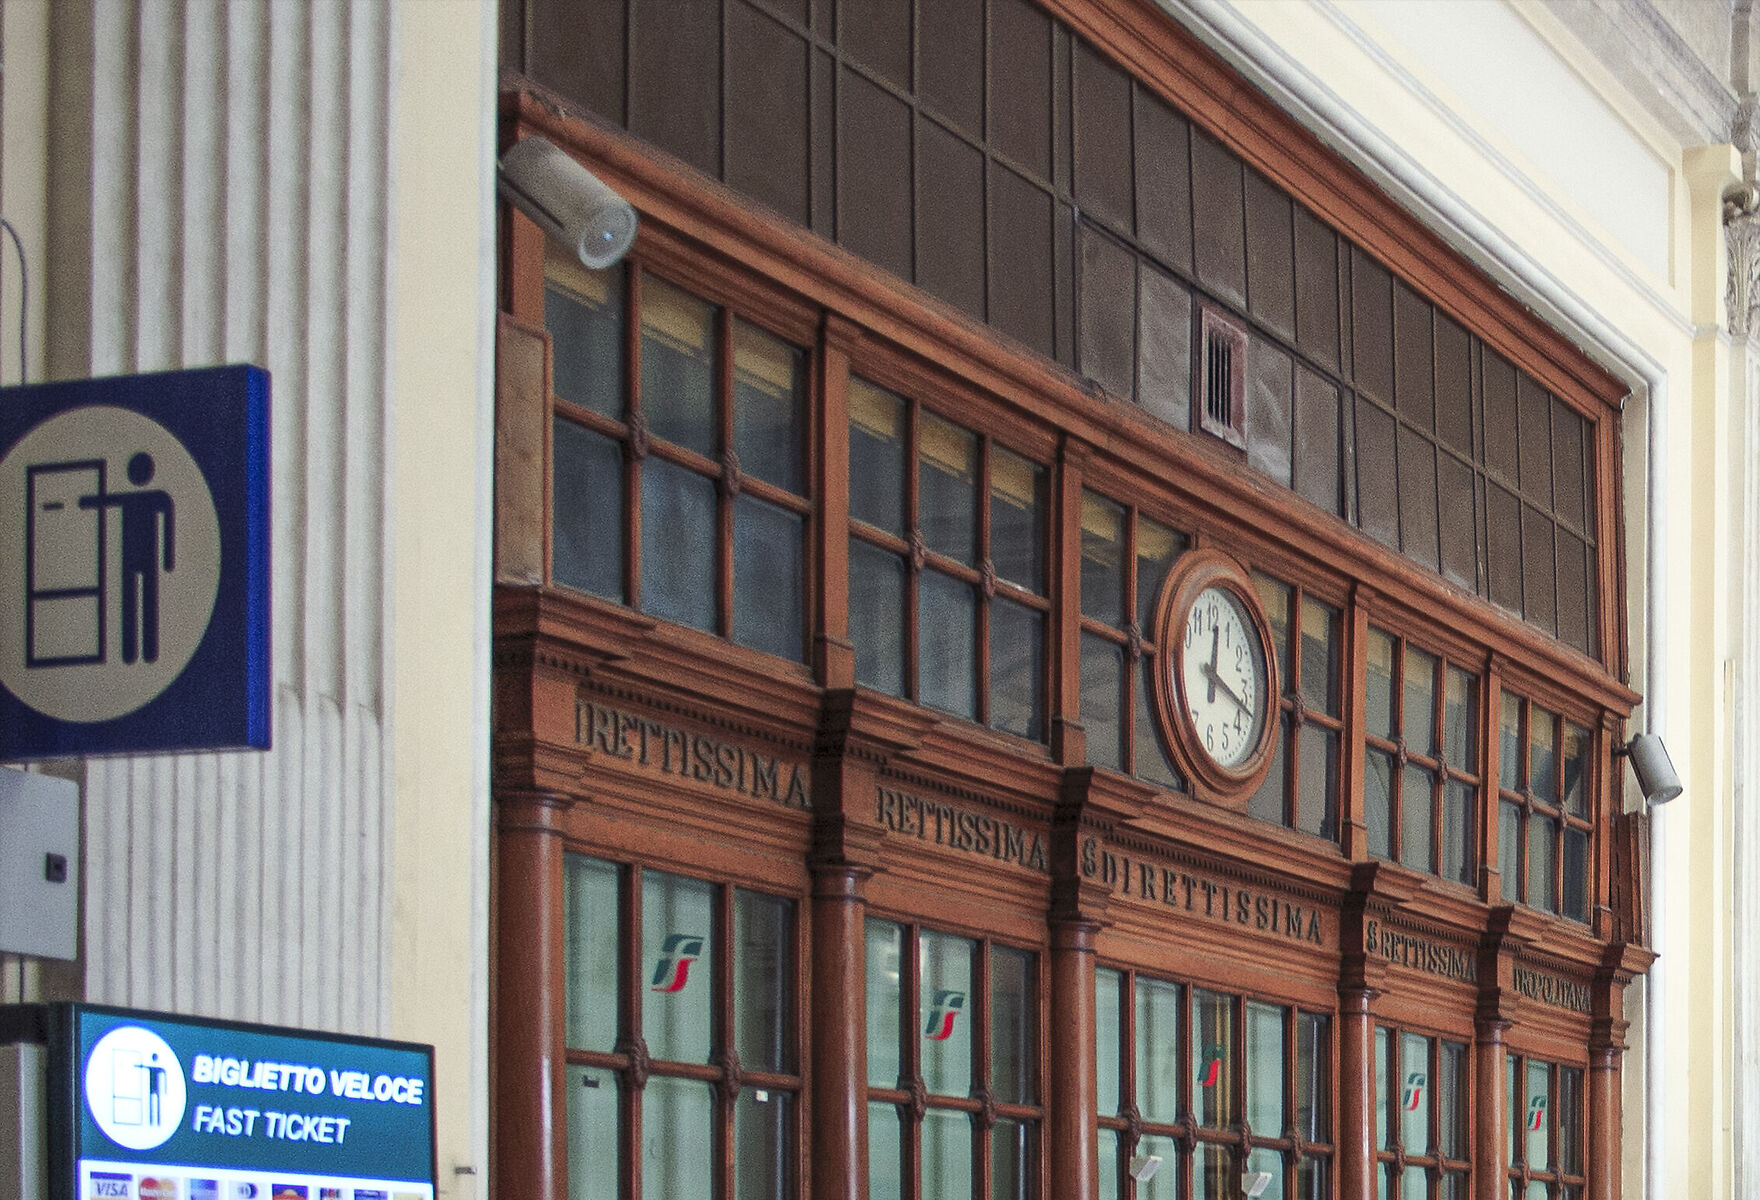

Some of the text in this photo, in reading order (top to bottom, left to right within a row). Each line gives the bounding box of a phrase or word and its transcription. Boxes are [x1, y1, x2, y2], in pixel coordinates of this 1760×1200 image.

[1193, 605, 1202, 636] 11
[1207, 601, 1218, 631] 12
[1235, 645, 1243, 672] 2
[1241, 679, 1248, 709] 3
[1222, 722, 1229, 749] 5
[1233, 708, 1242, 735] 4
[1206, 724, 1213, 752] 6
[192, 1054, 424, 1106] BIGLIETTO VELOCE
[192, 1104, 352, 1145] FAST TICKET
[95, 1182, 128, 1197] VISA
